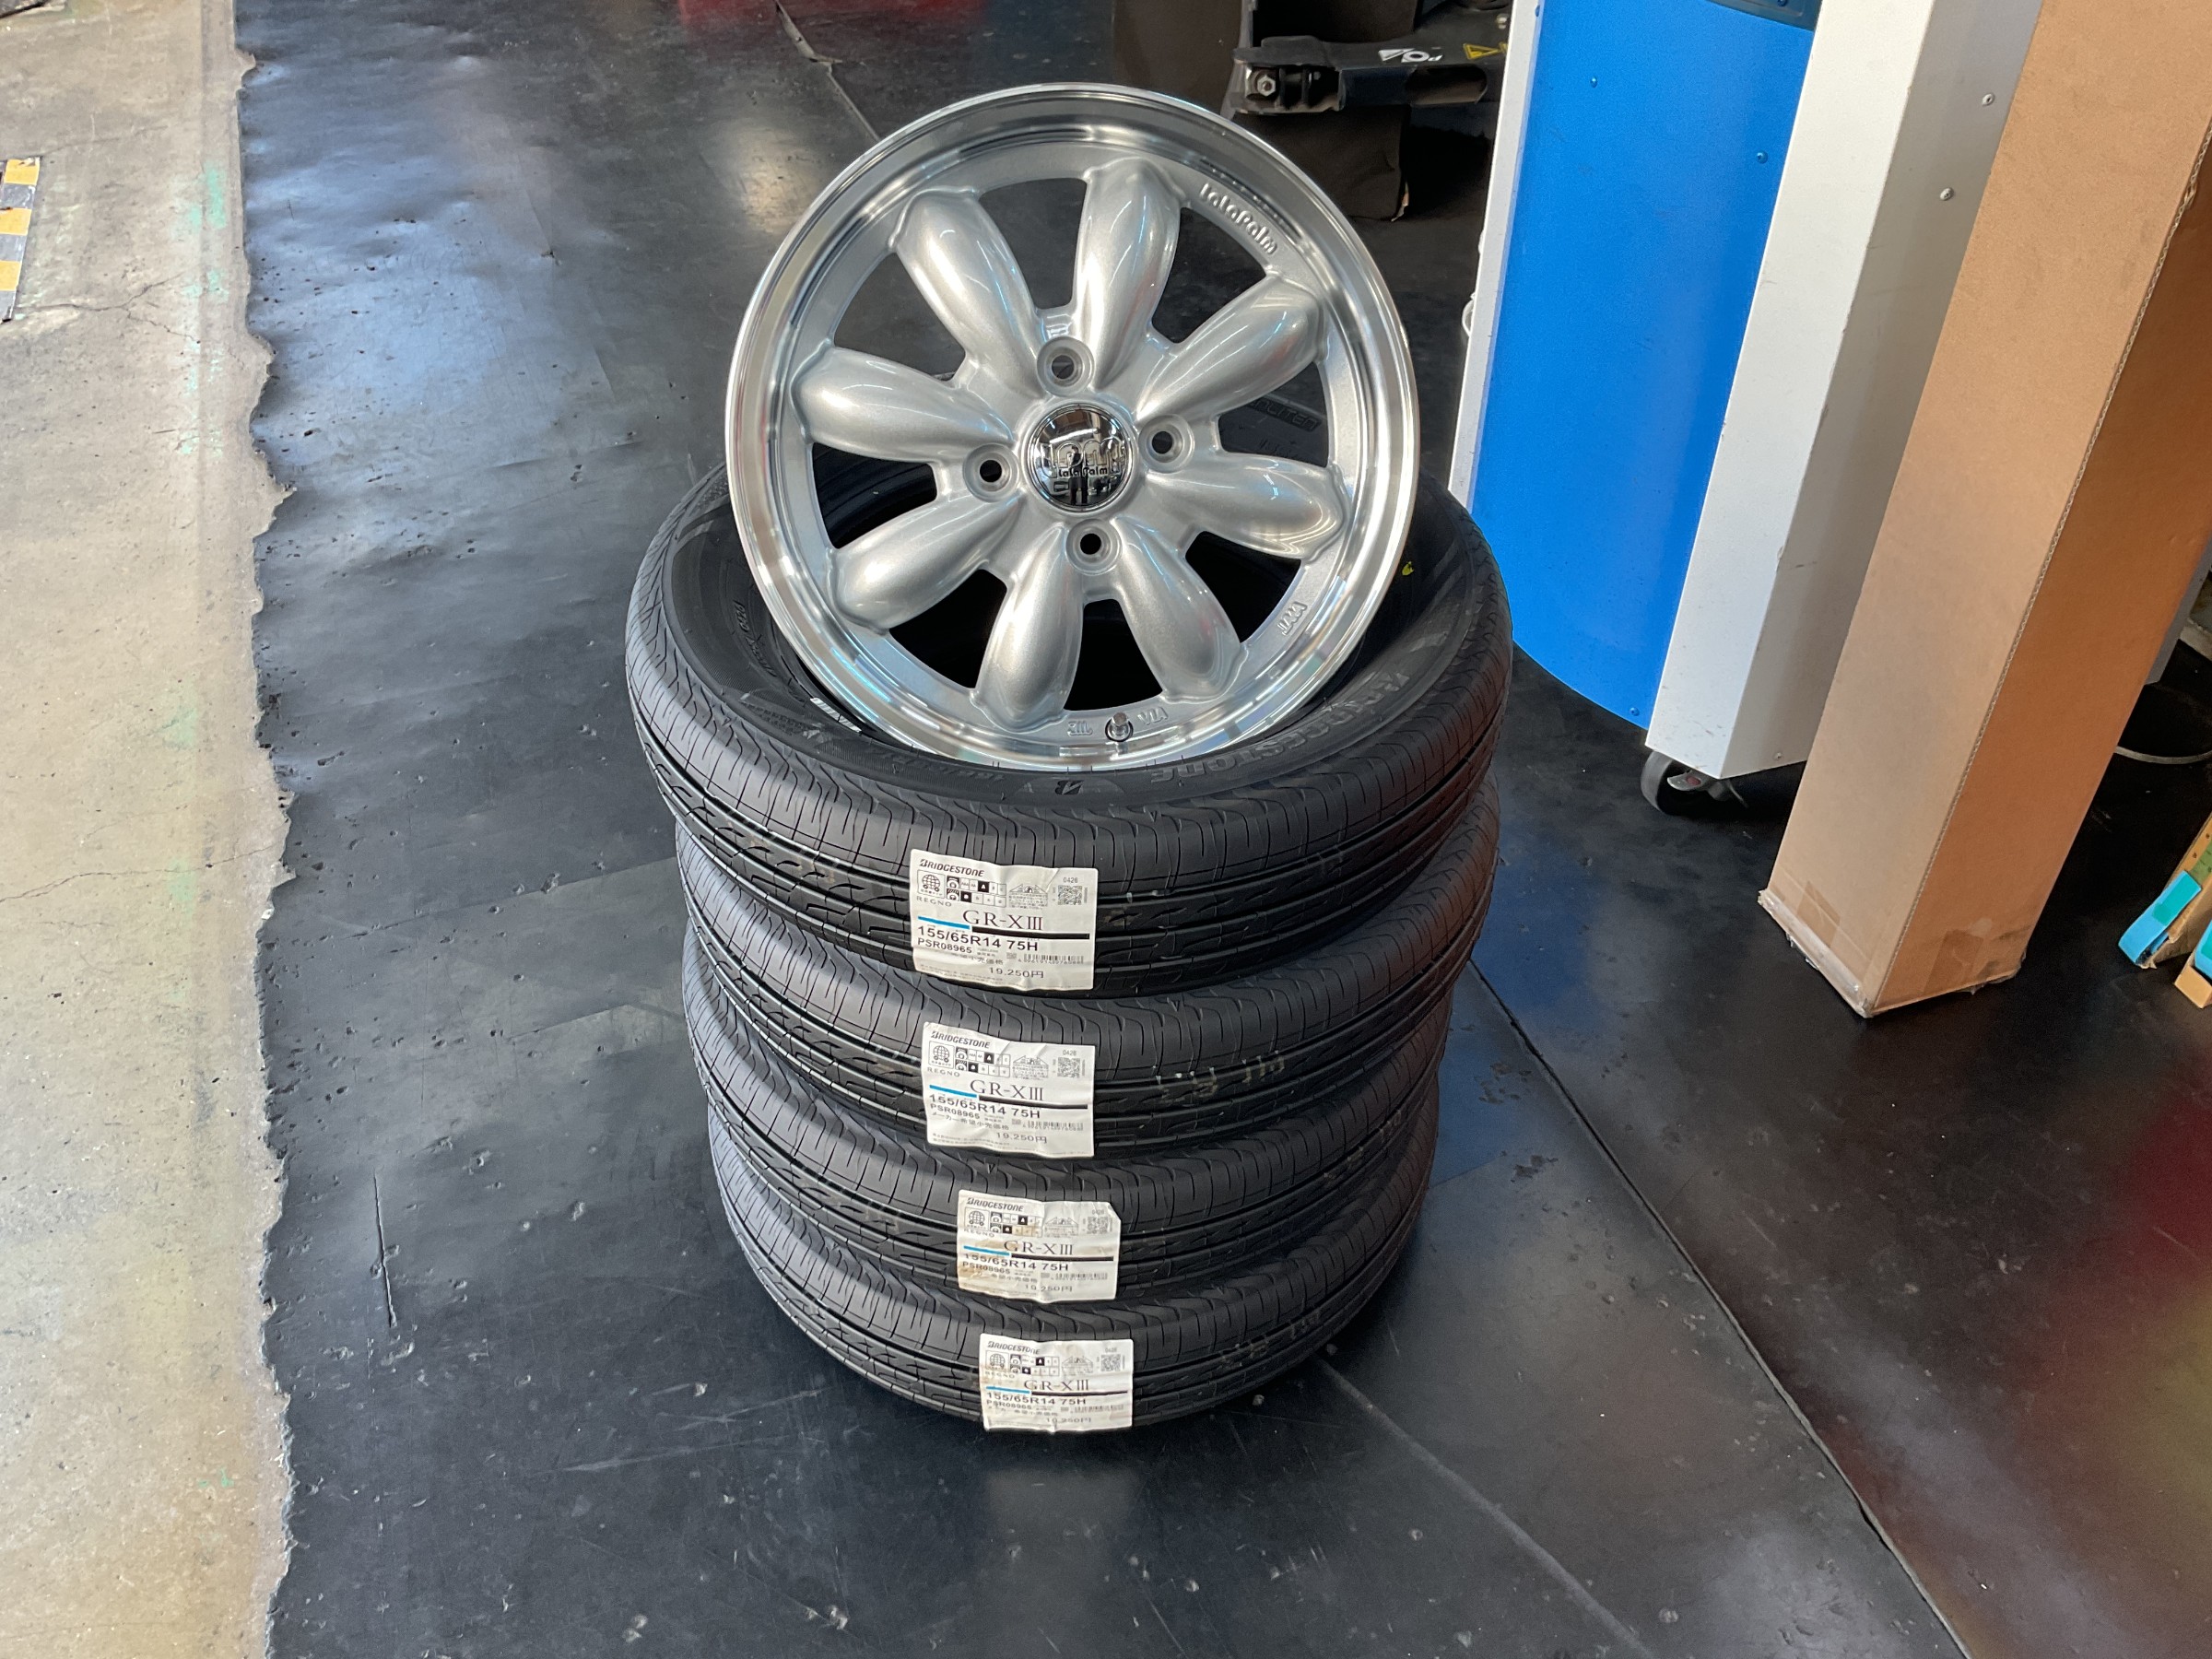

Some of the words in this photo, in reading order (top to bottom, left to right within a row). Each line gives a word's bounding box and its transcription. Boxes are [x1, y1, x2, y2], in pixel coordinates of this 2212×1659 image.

[920, 859, 984, 877] BRIDGESTONE
[917, 896, 951, 906] REGNO
[918, 926, 1001, 947] 155/65R14
[1006, 940, 1038, 951] 75H
[918, 938, 971, 953] PSR08965
[931, 1031, 990, 1049] BRIDGESTONE
[927, 1067, 959, 1077] REGNO
[930, 1094, 1006, 1114] 155/65R14
[1011, 1108, 1040, 1118] 75H
[931, 1103, 980, 1119] PSR08965
[967, 1198, 1024, 1211] BRIDGESTONE
[963, 1262, 1010, 1274] PSR08965
[964, 1253, 1036, 1270] 155/65R14
[988, 1341, 1040, 1354] BRIDGESTONE
[988, 1393, 1054, 1405] 155/65R14
